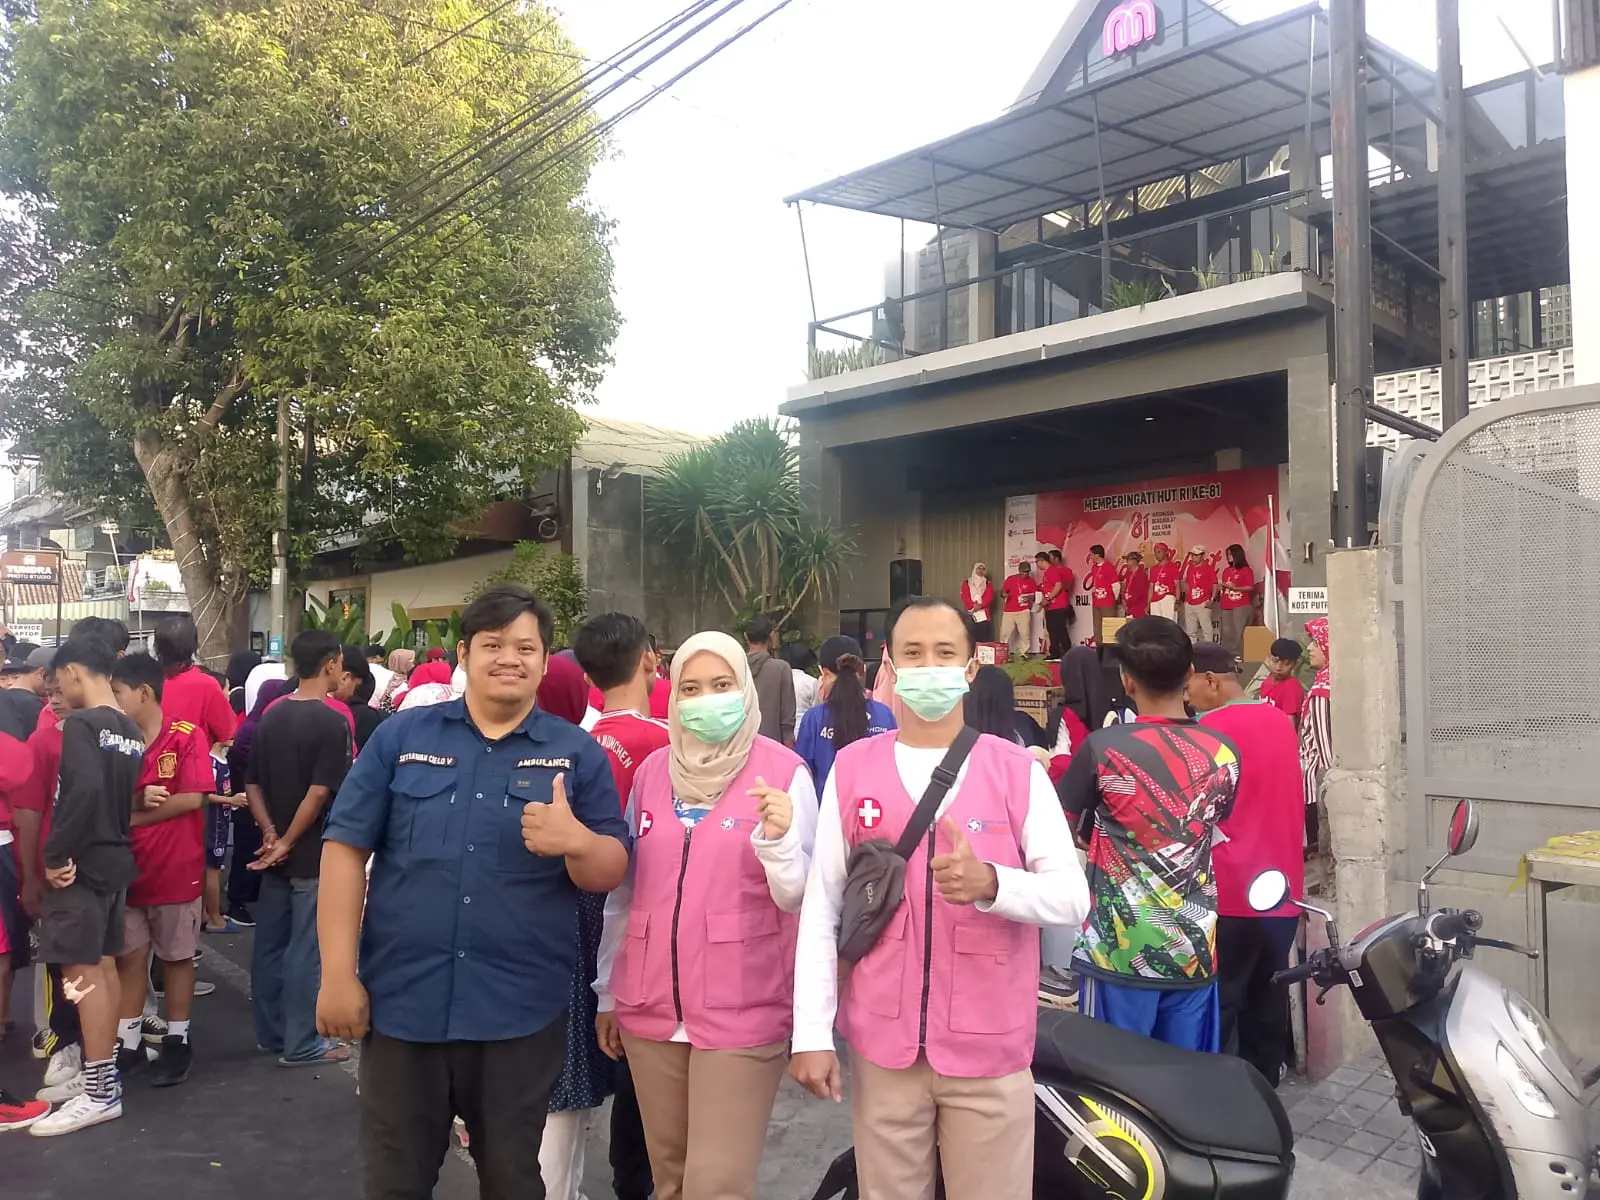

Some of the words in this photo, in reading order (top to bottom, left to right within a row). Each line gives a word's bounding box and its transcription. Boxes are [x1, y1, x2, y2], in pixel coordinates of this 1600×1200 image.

[1084, 492, 1155, 511] MEMPERINGATI
[1158, 489, 1177, 503] HUT
[1180, 488, 1190, 500] RI
[1192, 484, 1221, 499] KE-81
[1131, 511, 1150, 540] 81
[6, 565, 52, 574] TUNDRA
[1298, 591, 1325, 600] TERIMA
[1291, 601, 1309, 609] KOST
[517, 758, 571, 768] AMBULANCE
